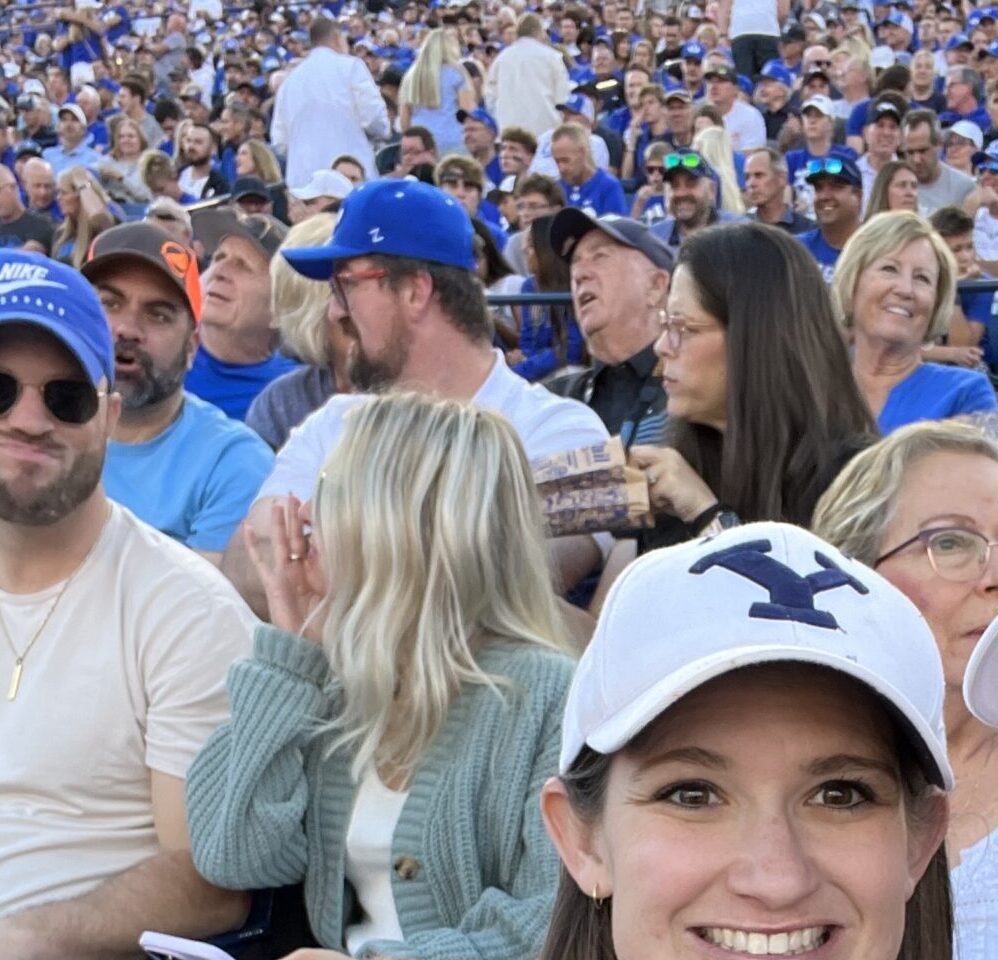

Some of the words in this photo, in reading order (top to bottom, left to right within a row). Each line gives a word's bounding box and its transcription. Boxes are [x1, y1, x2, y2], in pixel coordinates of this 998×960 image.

[368, 227, 385, 243] Z
[0, 262, 49, 281] NIKE
[688, 538, 870, 630] Y
